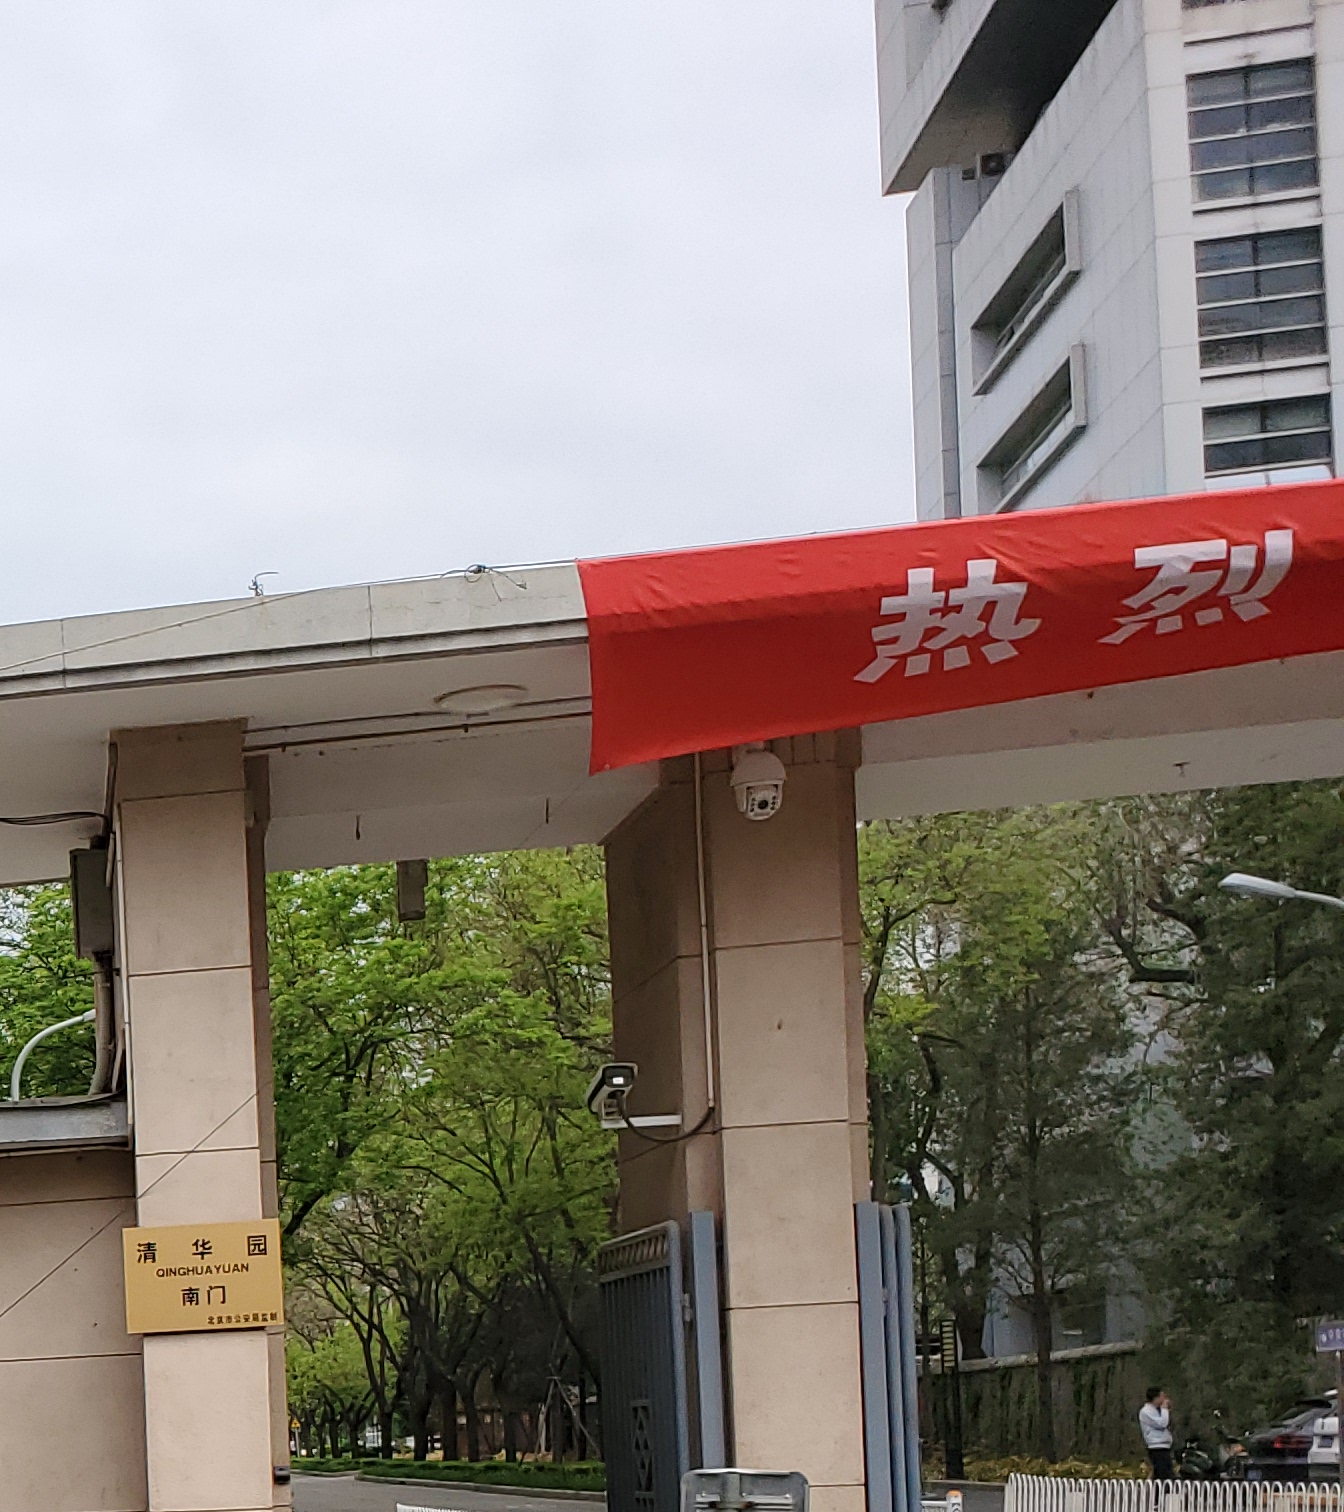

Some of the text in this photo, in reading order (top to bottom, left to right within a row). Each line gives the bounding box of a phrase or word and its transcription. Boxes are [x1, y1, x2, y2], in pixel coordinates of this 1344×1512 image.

[853, 528, 1294, 684] 热烈
[136, 1235, 268, 1265] 清华园
[156, 1263, 249, 1278] QINGHUAYUAN
[180, 1285, 227, 1306] 南门
